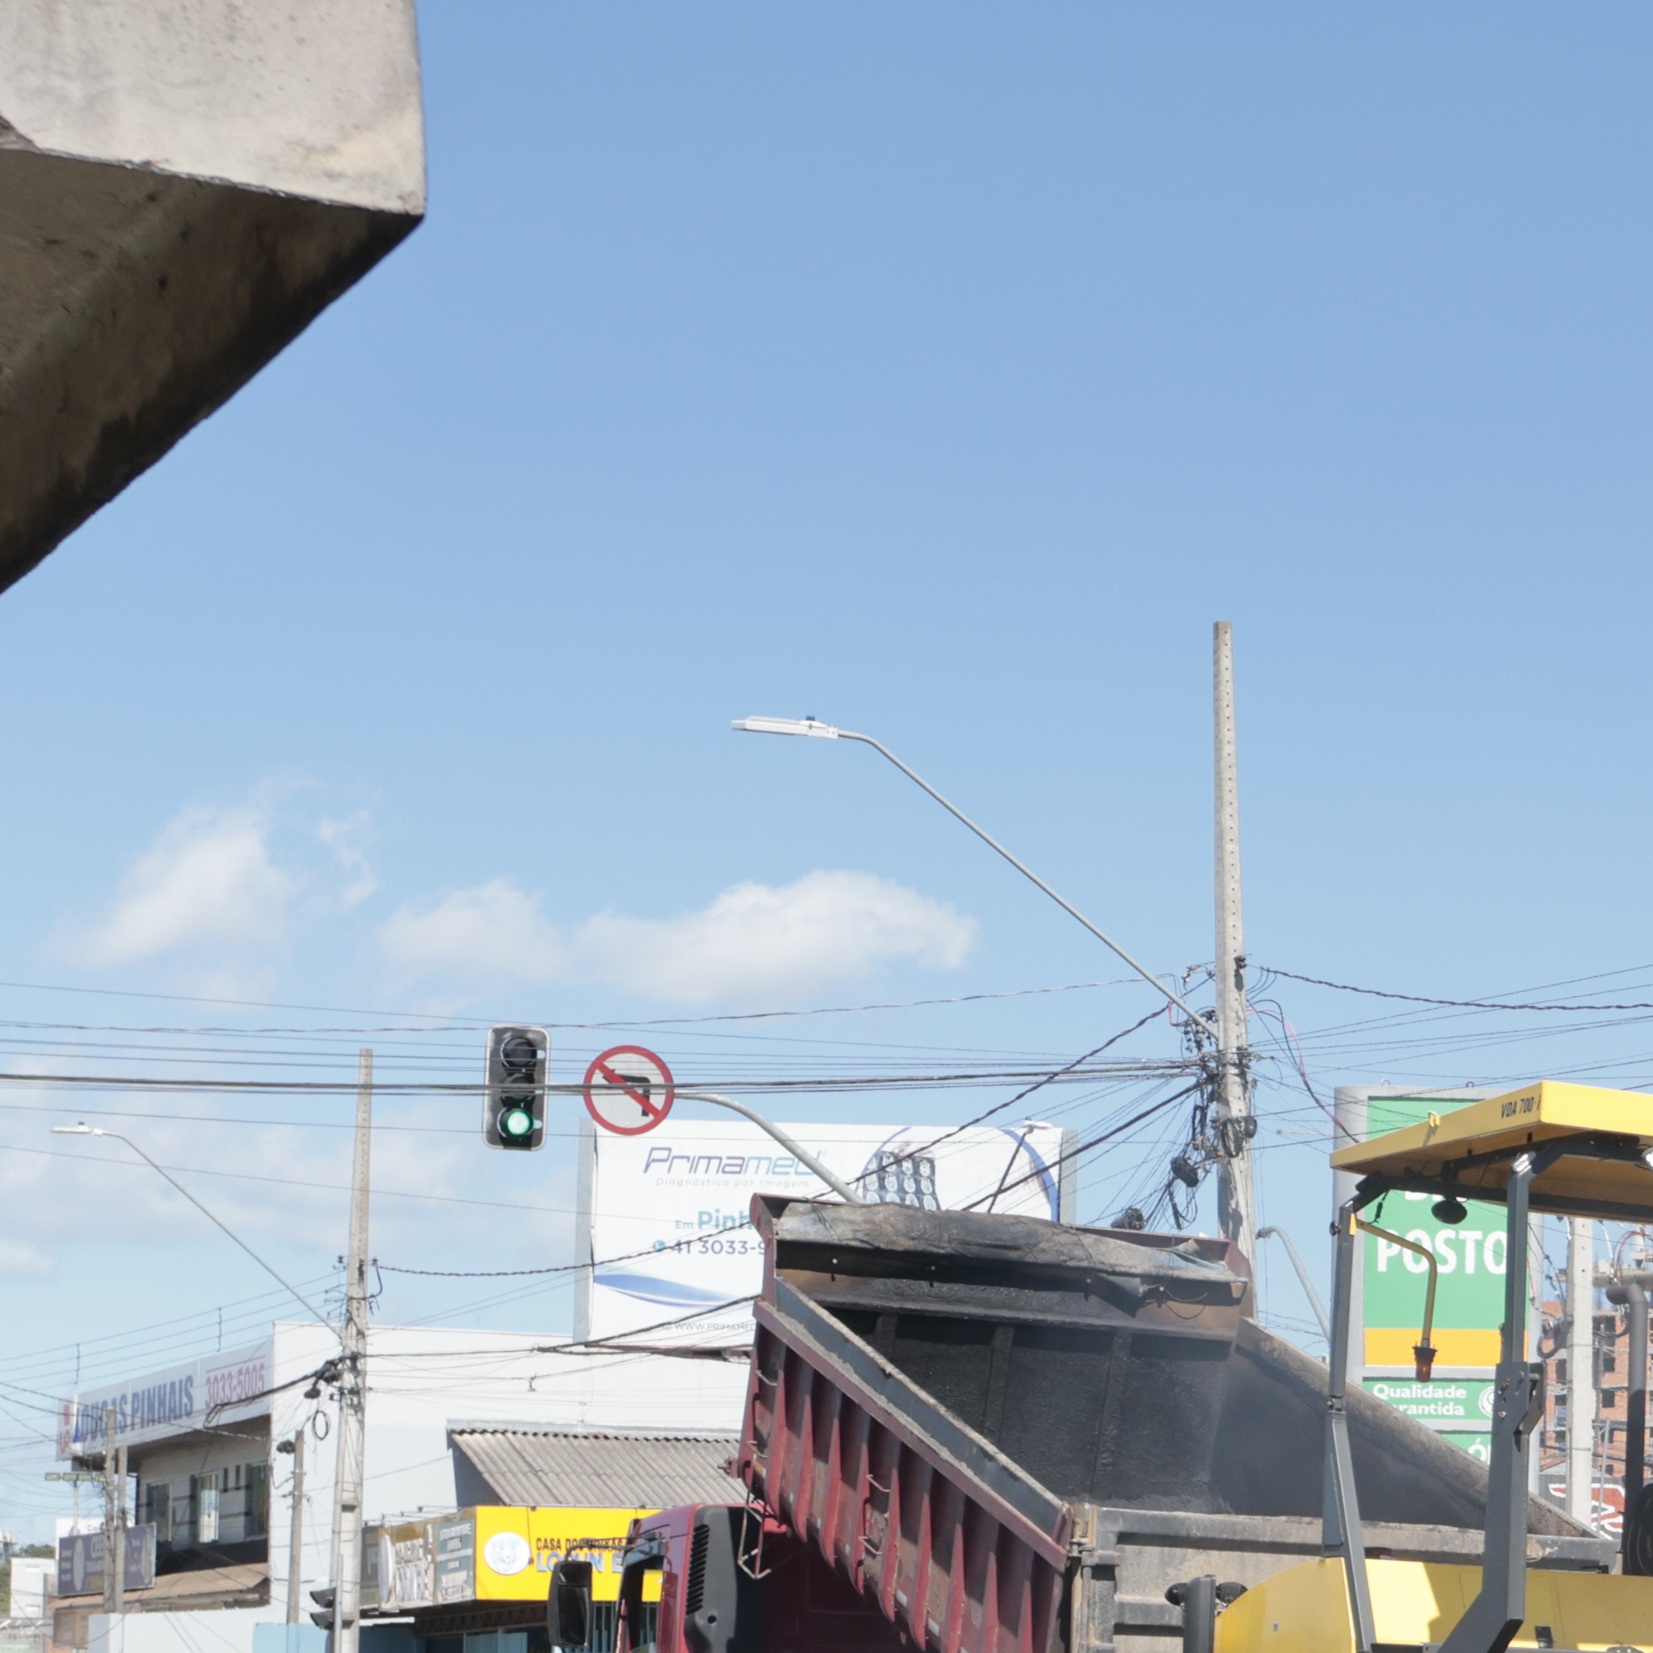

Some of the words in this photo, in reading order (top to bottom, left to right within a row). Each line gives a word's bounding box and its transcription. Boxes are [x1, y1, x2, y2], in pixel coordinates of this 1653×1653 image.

[1501, 1103, 1517, 1119] VDA
[643, 1146, 821, 1176] Primamed
[656, 1177, 731, 1187] Diagnóstico
[734, 1179, 754, 1188] por
[759, 1178, 809, 1188] Imagem
[675, 1220, 694, 1229] Em
[697, 1208, 753, 1230] Pinh
[671, 1240, 692, 1254] 41
[698, 1240, 766, 1255] 3033-9
[1377, 1228, 1507, 1275] POSTO
[675, 1322, 756, 1332] WWW.PRIMAMED
[1373, 1384, 1467, 1400] Qualidade
[131, 1375, 193, 1430] PINHAIS
[1399, 1402, 1466, 1416] rantida
[536, 1538, 561, 1551] CASA
